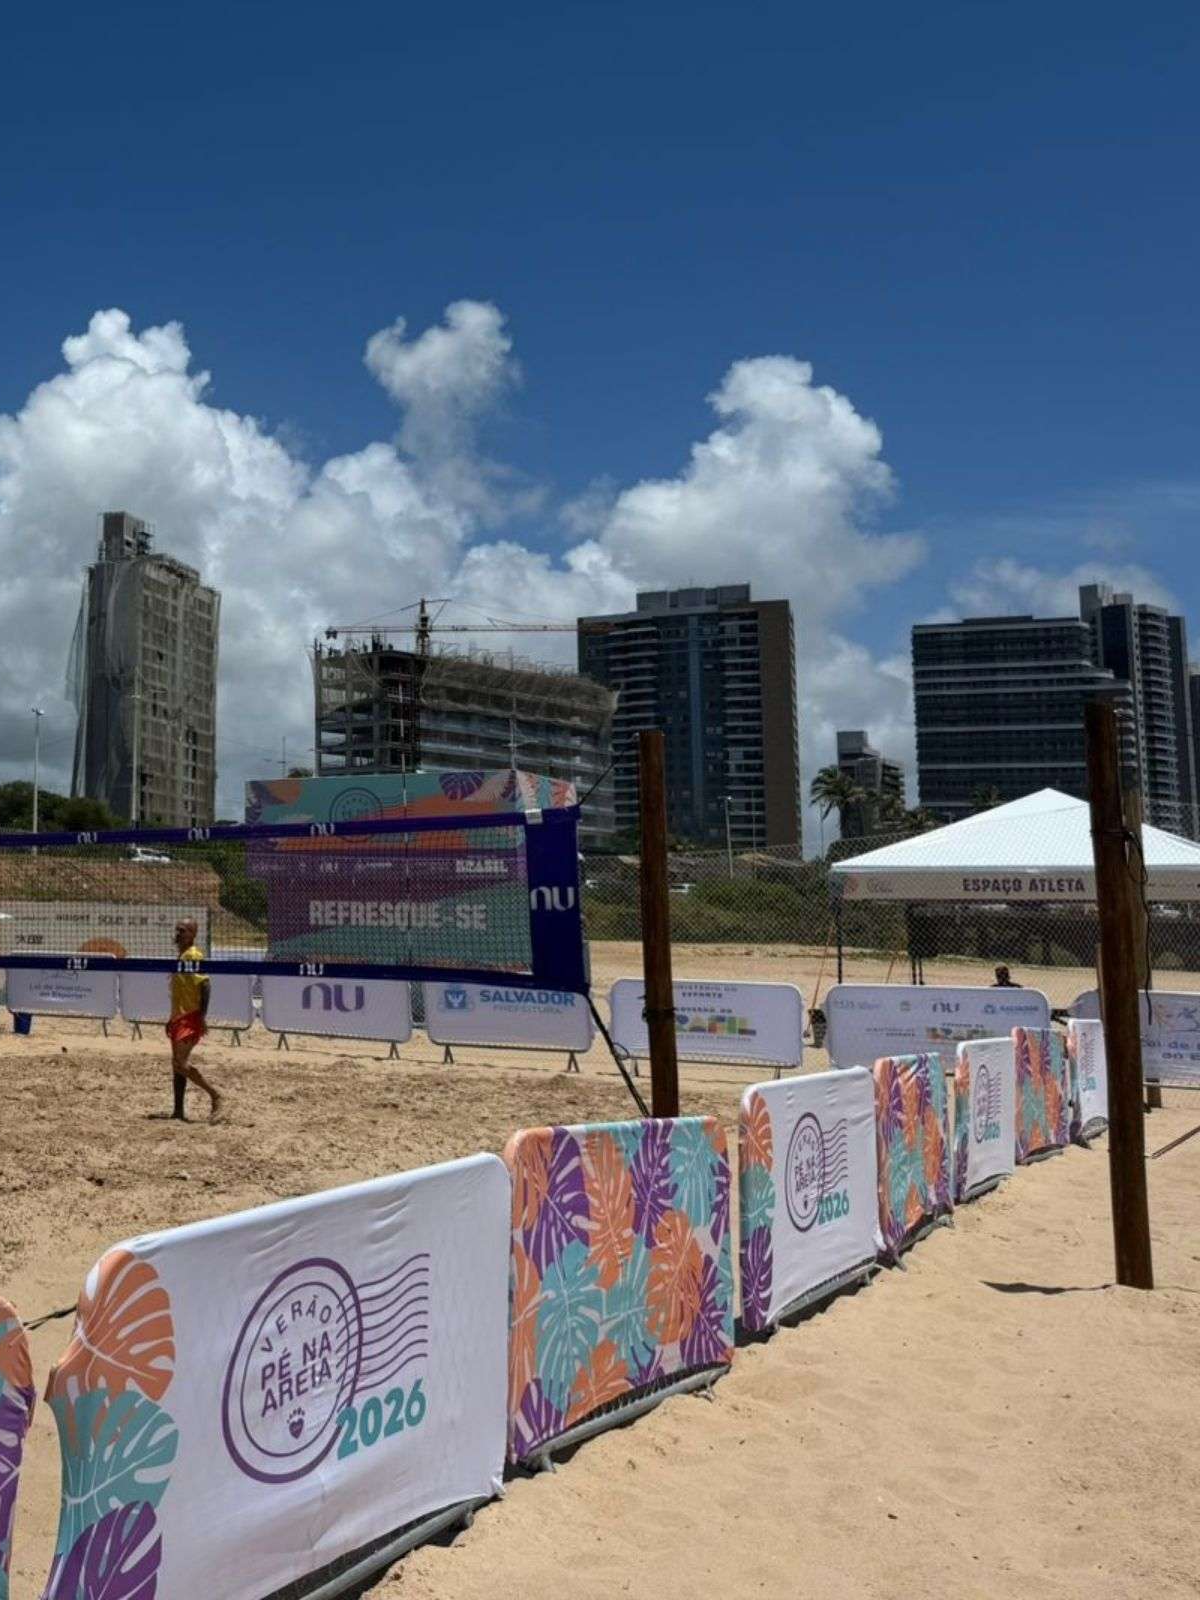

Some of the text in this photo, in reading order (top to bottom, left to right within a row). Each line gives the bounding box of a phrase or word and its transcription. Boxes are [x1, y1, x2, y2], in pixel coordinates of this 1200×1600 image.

[1028, 878, 1085, 892] ATLETA
[480, 990, 575, 1006] SALVADOR
[818, 1189, 849, 1225] 2026
[261, 1294, 332, 1353] VERÃO
[261, 1331, 332, 1391] PÉ NA
[261, 1358, 332, 1418] AREIA
[336, 1377, 427, 1461] 2026
